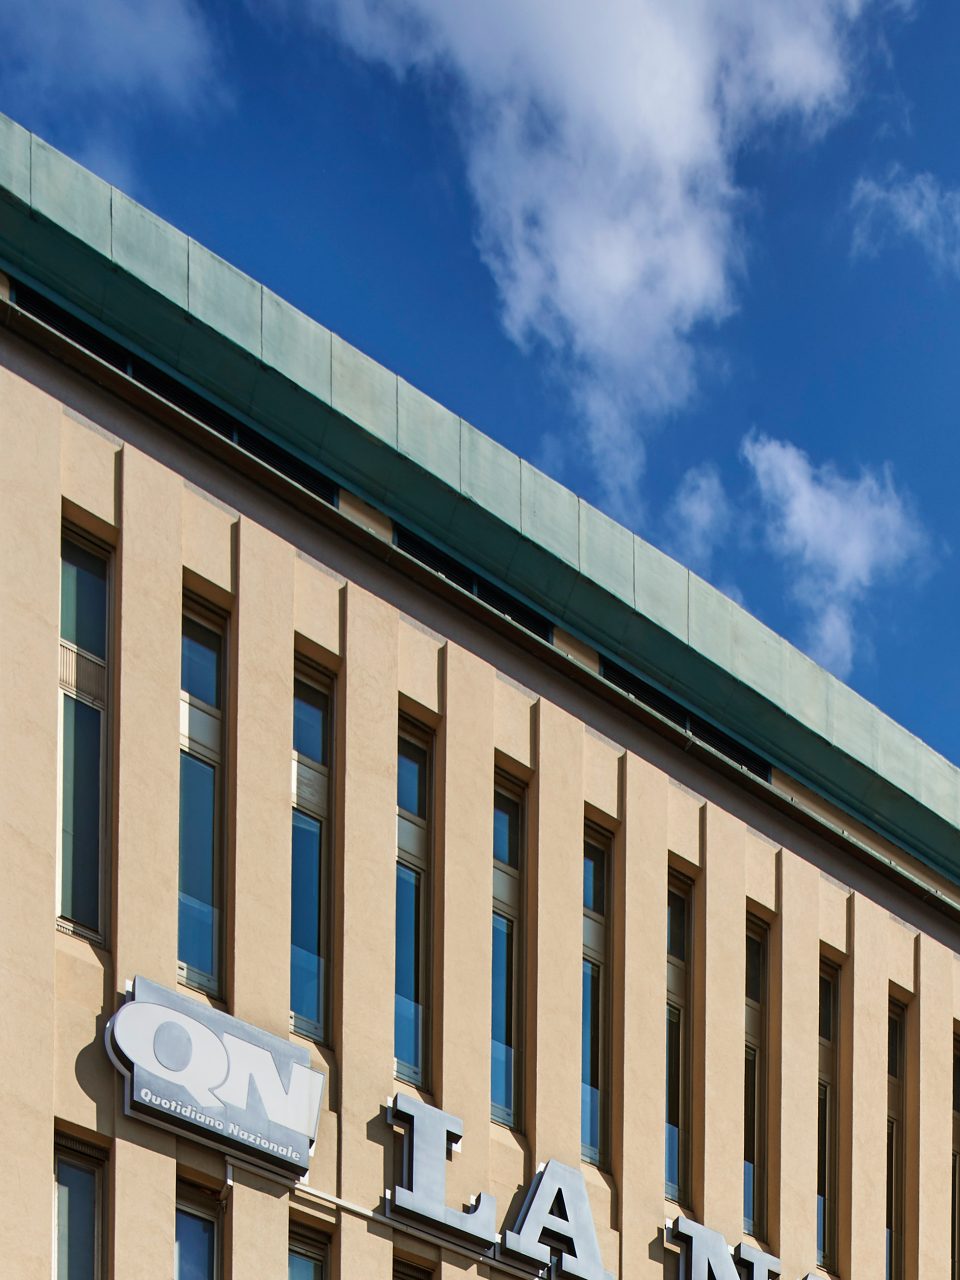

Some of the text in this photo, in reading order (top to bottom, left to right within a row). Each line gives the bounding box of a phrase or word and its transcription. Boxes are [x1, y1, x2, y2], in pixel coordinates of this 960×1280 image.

[112, 1000, 325, 1142] QN
[140, 1087, 301, 1161] Quotidiano Nazionale
